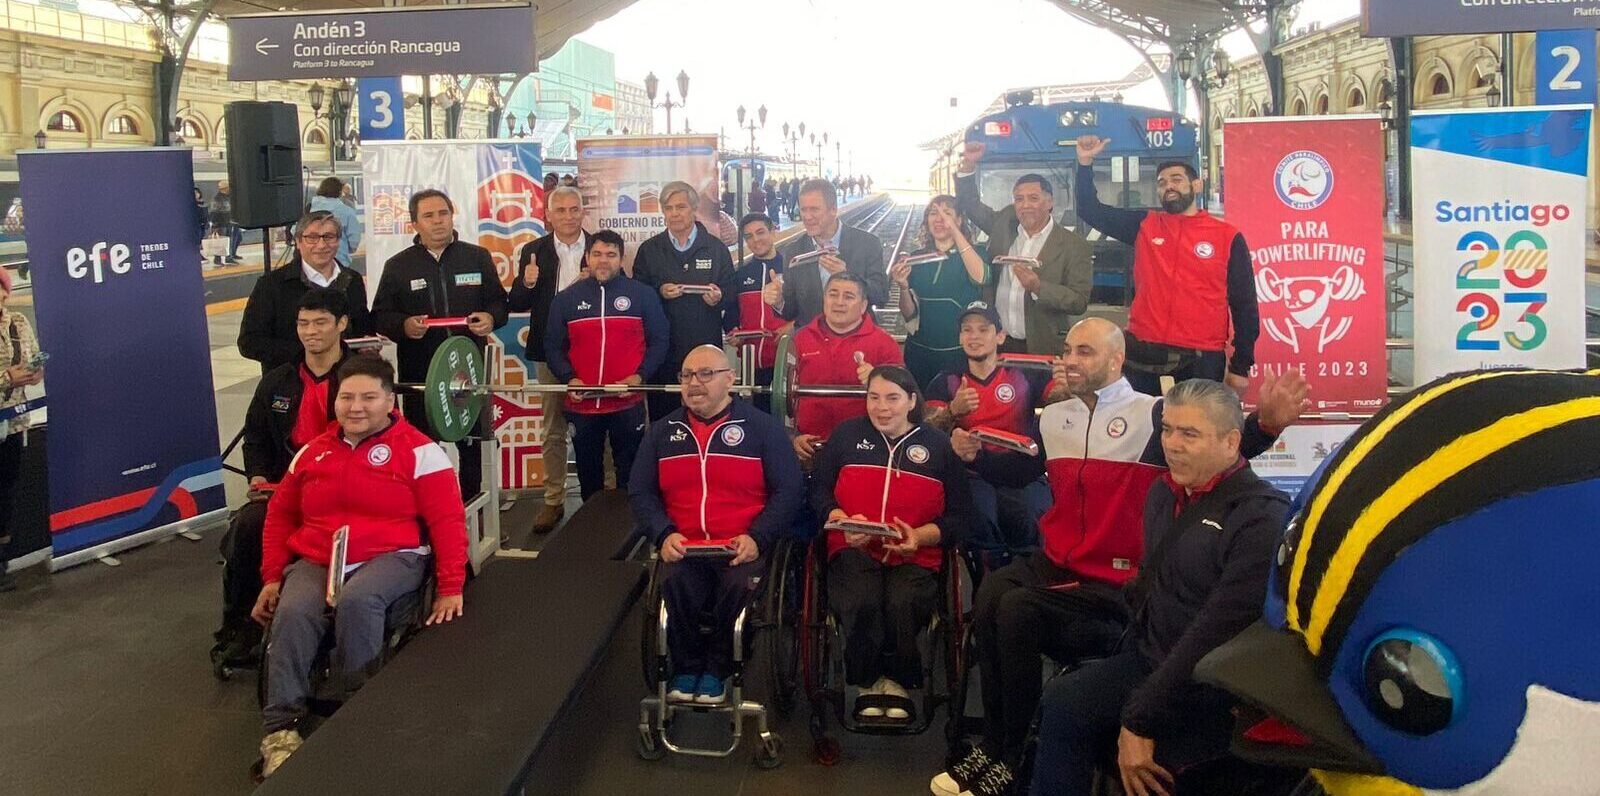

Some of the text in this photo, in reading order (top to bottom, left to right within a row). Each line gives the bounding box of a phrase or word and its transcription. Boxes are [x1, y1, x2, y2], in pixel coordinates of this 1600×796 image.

[293, 20, 366, 40] Andén 3
[293, 39, 461, 57] Con dirección Rancagua
[293, 60, 323, 68] Platform
[324, 59, 330, 67] 3
[338, 59, 374, 68] Rancagua
[1549, 45, 1582, 90] 2
[370, 90, 393, 129] 3
[1146, 130, 1174, 148] 103
[1435, 199, 1570, 227] Santiago
[598, 217, 649, 229] GOBIERNO
[1280, 220, 1329, 240] PARA
[66, 241, 131, 283] efe
[141, 253, 151, 261] DE
[1250, 243, 1366, 266] POWERLIFTING
[142, 260, 164, 270] CHILE
[1318, 361, 1368, 377] 2023
[438, 381, 453, 428] ELEIKO
[856, 442, 876, 450] KS7
